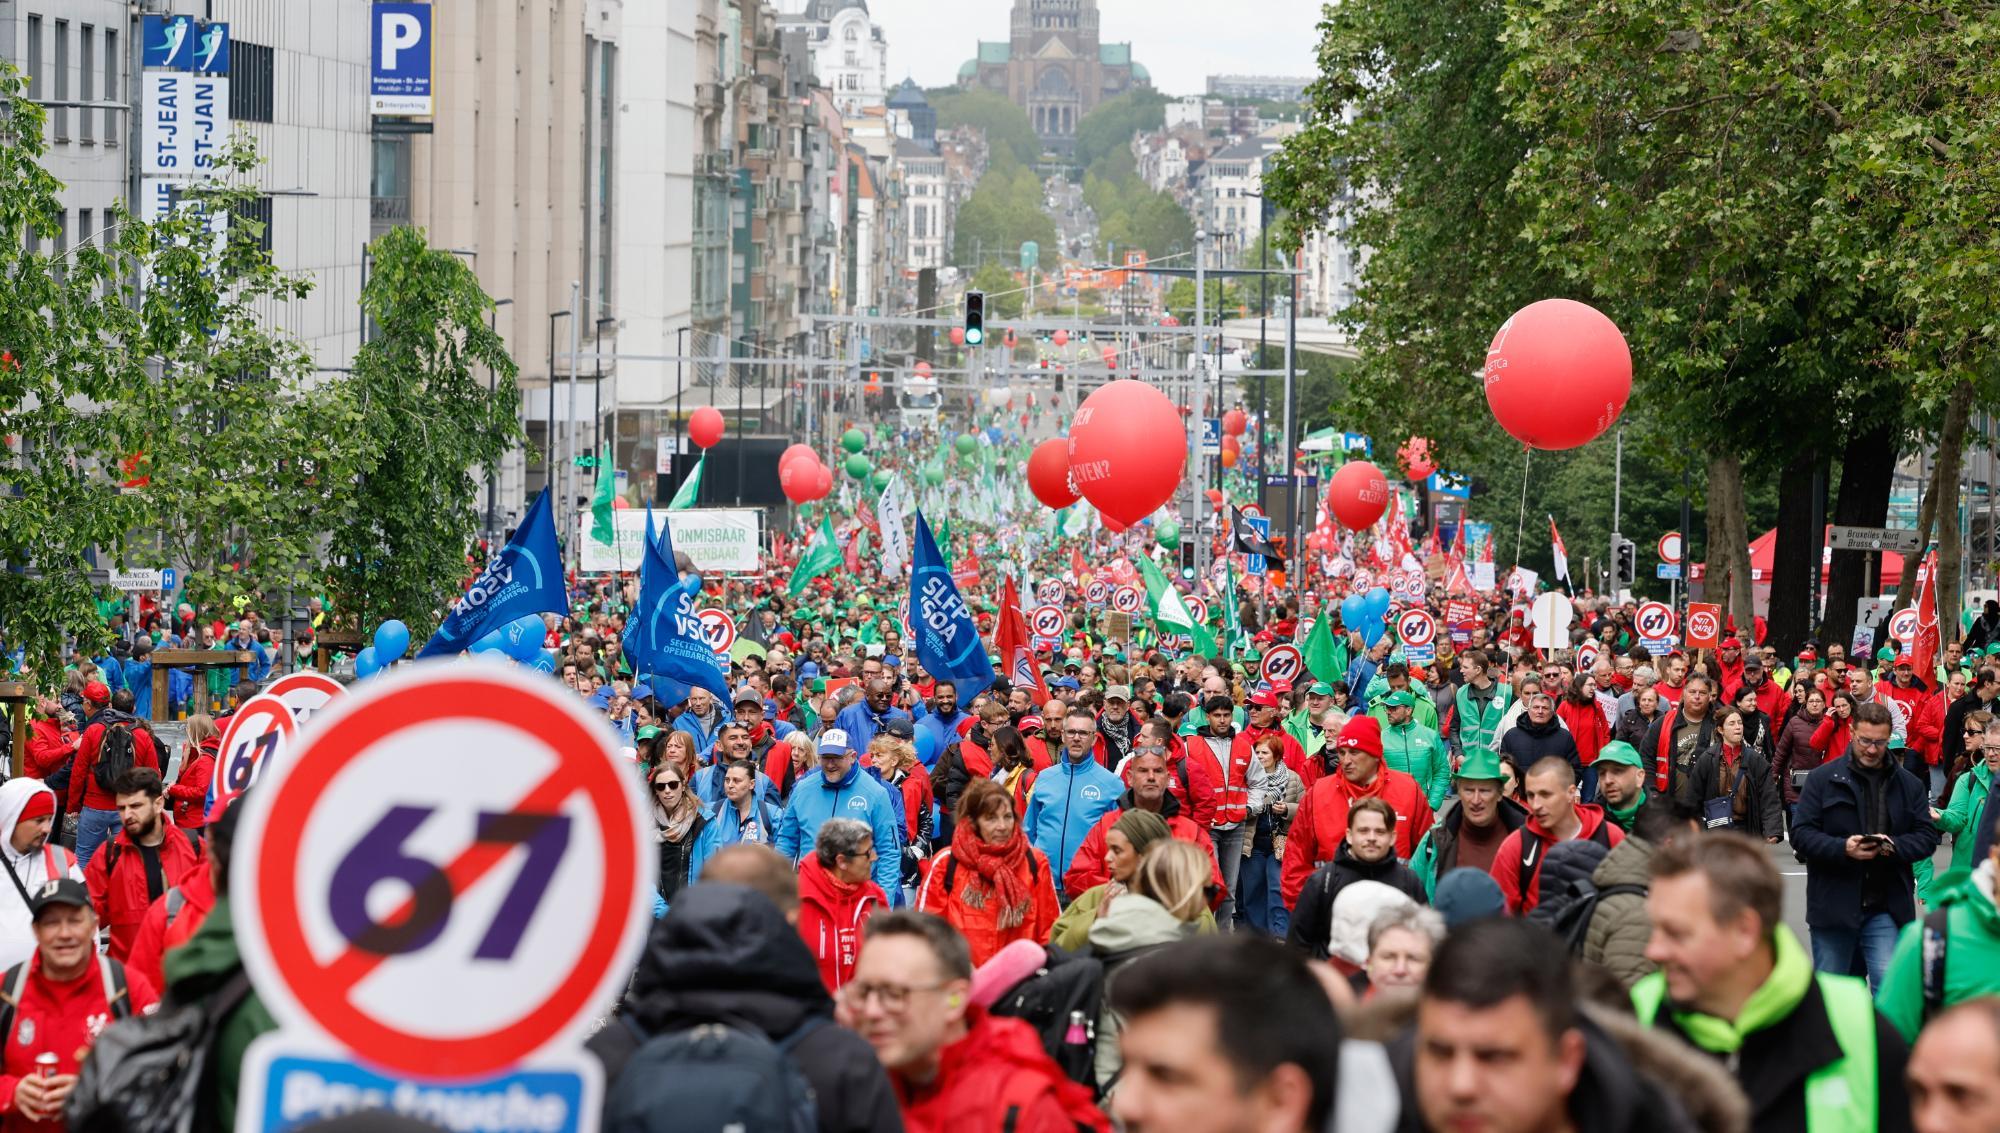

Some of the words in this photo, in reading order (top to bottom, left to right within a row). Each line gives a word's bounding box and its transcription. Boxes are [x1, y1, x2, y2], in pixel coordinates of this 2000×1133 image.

[382, 13, 422, 70] P
[158, 78, 177, 167] ST-JEAN
[195, 84, 213, 168] ST-JAN
[677, 528, 746, 544] ONMISBAAR
[1847, 530, 1879, 539] Bruxelles
[1882, 531, 1899, 540] Nord
[1848, 539, 1873, 548] Brusse
[165, 573, 173, 585] H
[922, 577, 970, 621] SLFP
[1090, 587, 1104, 597] 67
[1119, 592, 1135, 605] 67
[675, 614, 712, 645] VSO
[1038, 616, 1058, 629] 67
[1405, 622, 1427, 637] 67
[1643, 614, 1666, 630] 67
[663, 645, 706, 661] OPENBARE
[670, 638, 704, 653] SECTEUR
[1268, 658, 1295, 675] 67
[1582, 656, 1591, 670] 6
[824, 733, 843, 742] SLFP
[229, 730, 278, 791] 67
[328, 806, 571, 960] 67
